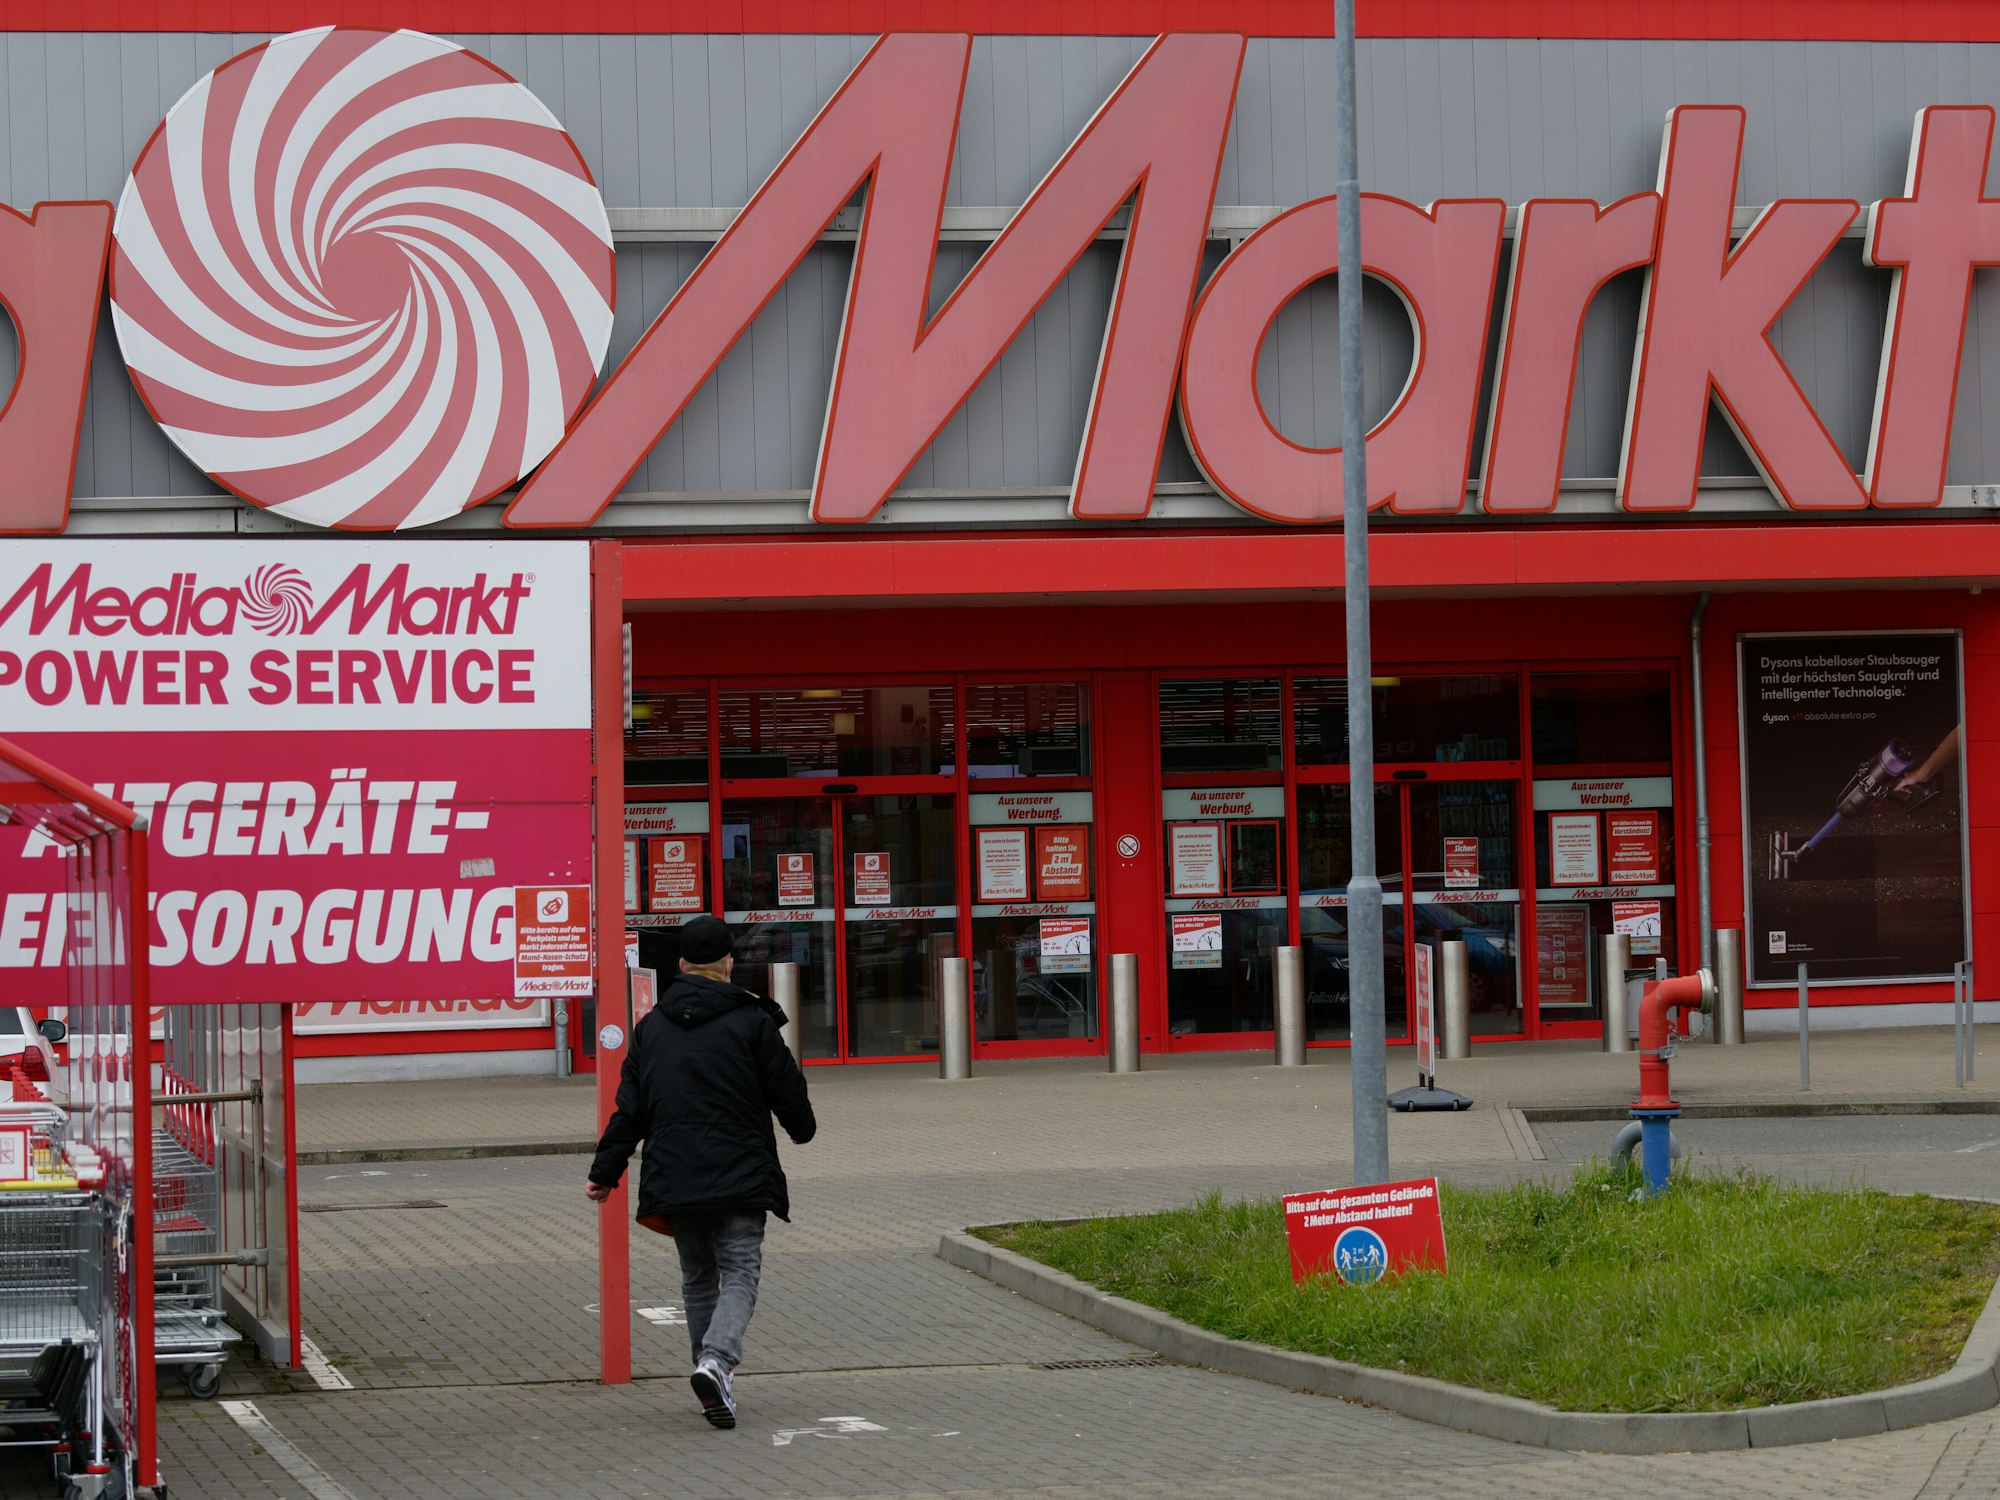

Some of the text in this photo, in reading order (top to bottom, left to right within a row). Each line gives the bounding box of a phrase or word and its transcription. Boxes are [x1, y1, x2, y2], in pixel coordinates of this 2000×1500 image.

[504, 32, 2000, 527] Markt
[0, 561, 531, 637] Media Markt
[1761, 654, 1940, 671] Dysons kabelloser Staubsauger
[248, 648, 535, 705] SERVICE
[1761, 669, 1939, 684] mit der höchsten Saugkraft und
[1762, 687, 1831, 701] intelligenter
[1762, 713, 1789, 724] dyson
[1804, 712, 1840, 720] absolute
[1863, 712, 1876, 721] pro
[1571, 782, 1624, 791] Aus unserer
[998, 796, 1053, 806] Aus unserer
[1190, 791, 1245, 801] Aus unserer
[1580, 793, 1633, 806] Werbung.
[22, 767, 489, 858] ATGERÄTE-
[629, 806, 667, 815] unserer
[1007, 808, 1062, 820] Werbung.
[1200, 802, 1254, 815] Werbung.
[1614, 827, 1651, 835] Verständnis!
[1045, 866, 1079, 875] Abstand
[1432, 891, 1499, 902] Media Markt
[1572, 888, 1639, 899] Media Markt
[1192, 898, 1260, 909] Media Markt
[1315, 896, 1347, 906] Media
[865, 908, 936, 919] Media Markt
[999, 904, 1069, 916] Media Markt
[651, 915, 682, 925] Markt
[743, 911, 815, 923] Media Markt
[0, 887, 516, 967] ENSORGUNG
[536, 926, 559, 934] bereits
[559, 926, 571, 934] auf
[526, 935, 557, 943] Parkplatz
[539, 943, 569, 951] jederzeit
[520, 953, 586, 961] Mund-Nasen-Schutz
[542, 964, 565, 972] tragen.
[519, 980, 589, 992] Media Markt
[1286, 1185, 1433, 1214] Bitte auf dem gesamten Gelände
[1304, 1203, 1413, 1227] 2 Meter Abstand halten!
